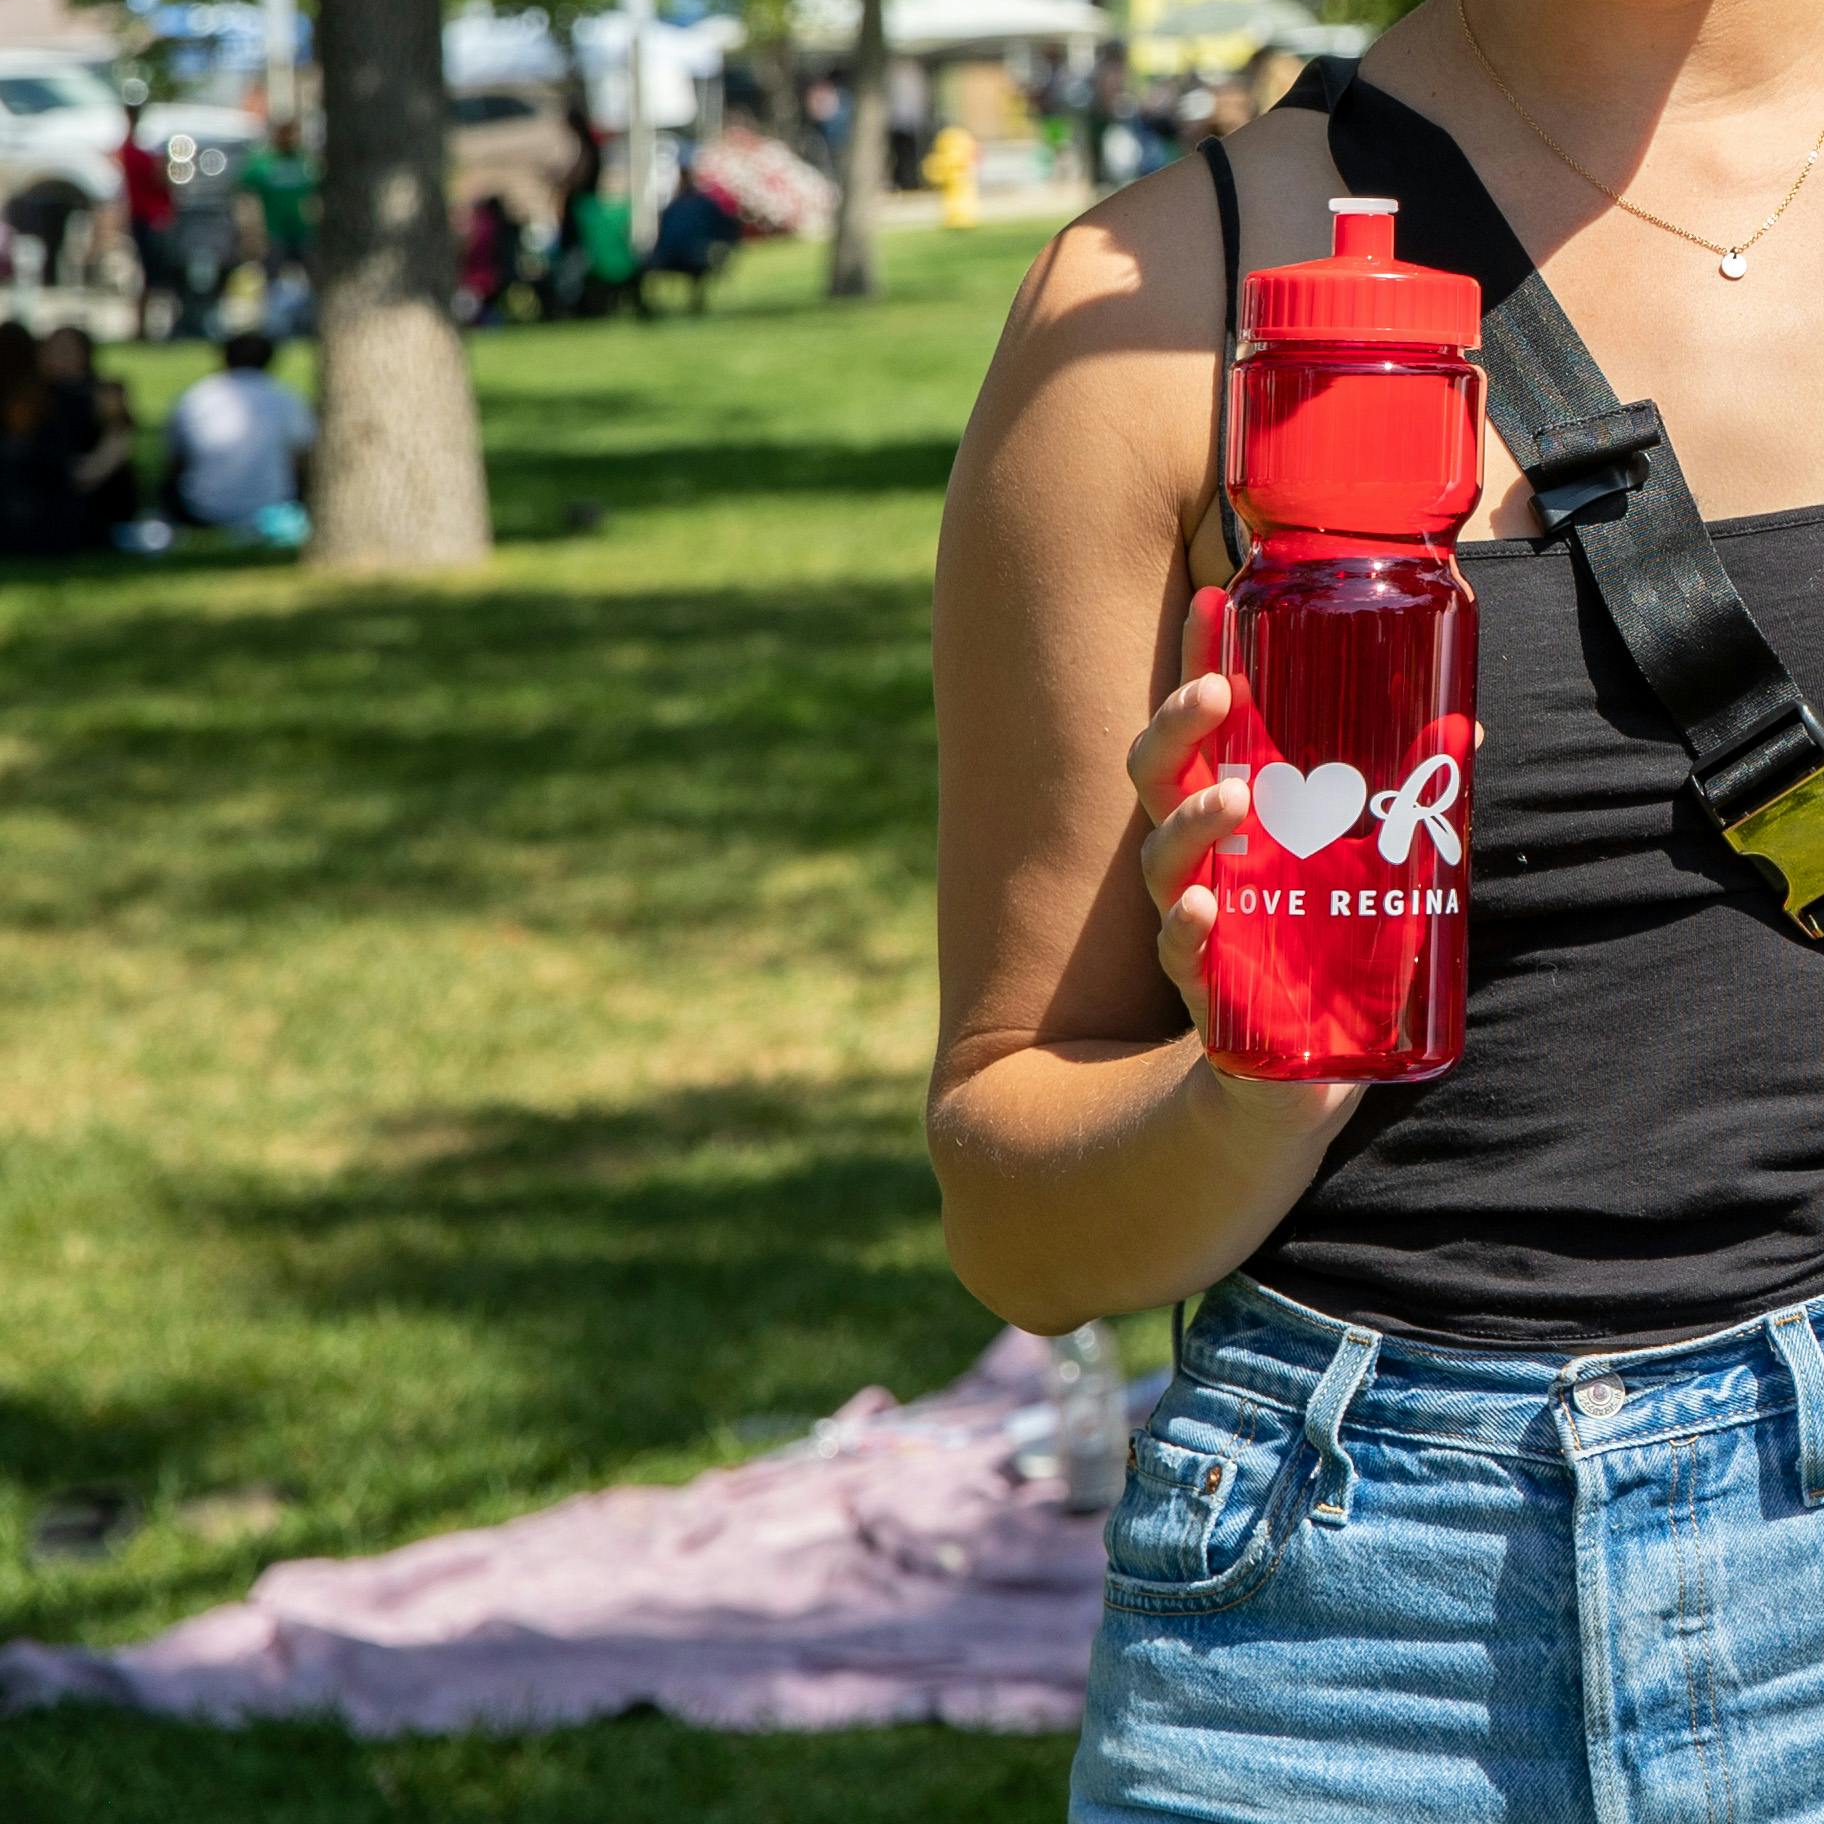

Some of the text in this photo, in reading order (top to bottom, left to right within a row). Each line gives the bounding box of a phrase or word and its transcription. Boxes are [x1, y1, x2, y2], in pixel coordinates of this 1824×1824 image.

[1369, 753, 1462, 866] R
[1226, 888, 1306, 916] LOVE
[1330, 888, 1460, 917] REGINA
